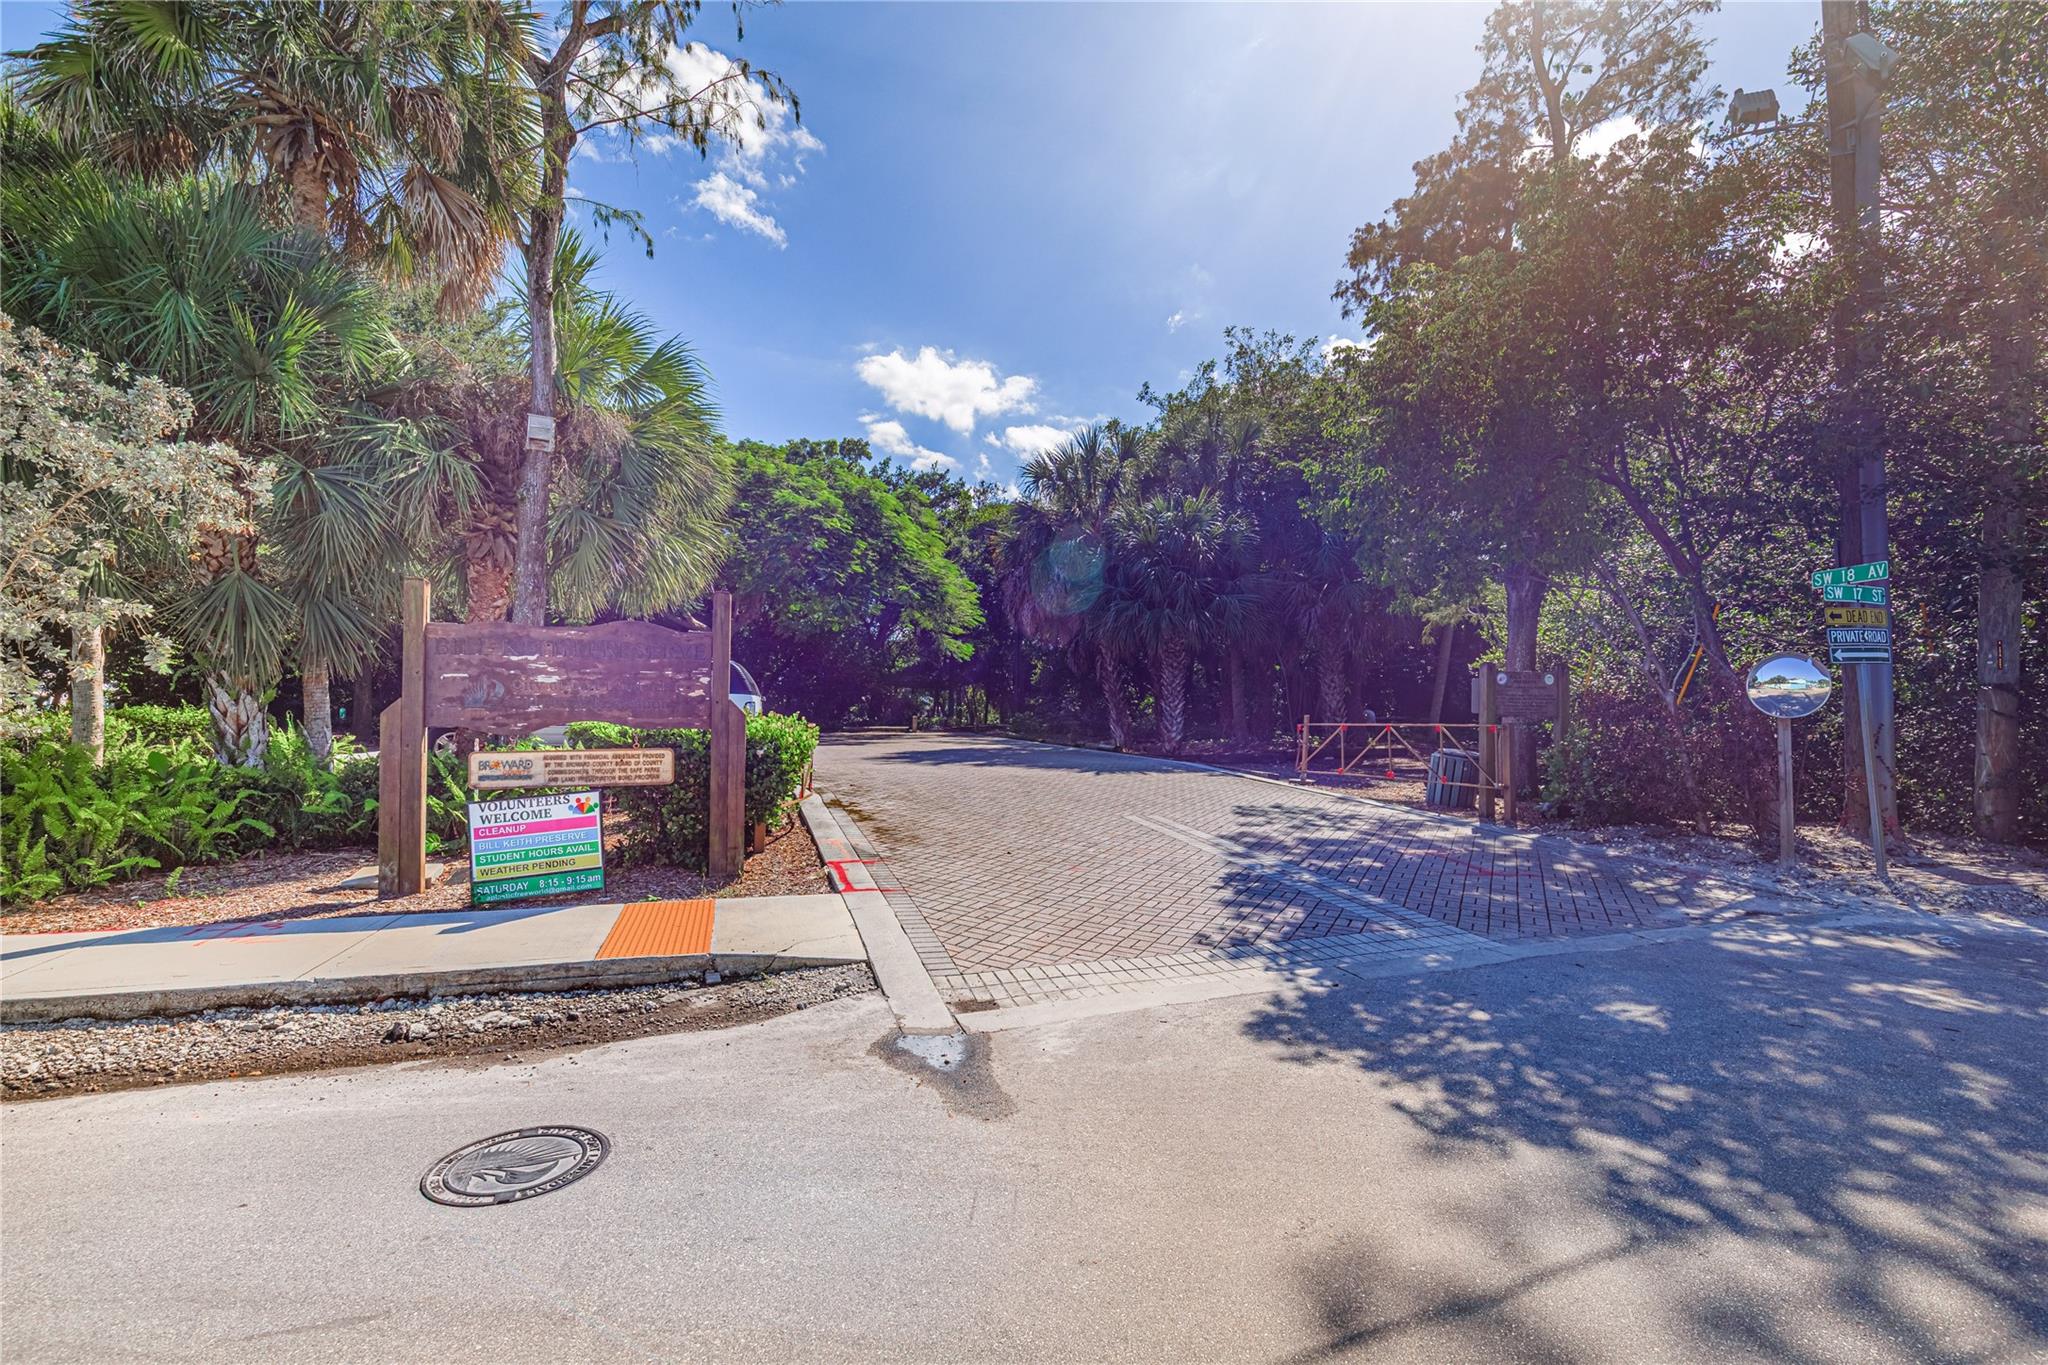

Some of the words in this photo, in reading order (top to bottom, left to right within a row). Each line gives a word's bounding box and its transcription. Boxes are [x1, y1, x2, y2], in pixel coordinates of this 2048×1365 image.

[1814, 572, 1832, 586] SW
[1841, 568, 1855, 582] 18
[1867, 563, 1885, 578] AV
[1827, 586, 1843, 599] SW
[1853, 588, 1863, 600] 17
[1872, 589, 1883, 602] ST
[1846, 610, 1868, 623] DEAD
[1870, 611, 1884, 624] END
[1830, 630, 1864, 643] PRIVATE
[1868, 631, 1887, 643] ROAD
[478, 795, 570, 813] VOLUNTEERS
[479, 808, 552, 825] WELCOME
[478, 824, 526, 836] CLEANUP
[479, 840, 501, 850] BILL
[503, 837, 532, 848] KEITH
[535, 831, 586, 845] PRESERVE
[479, 851, 526, 864] STUDENT
[528, 847, 564, 858] HOURS
[566, 844, 596, 854] AVAIL.
[480, 863, 529, 877] WEATHER
[532, 858, 576, 870] PENDING
[477, 881, 528, 896] SATURDAY
[539, 878, 559, 888] 8:15
[566, 874, 586, 885] 9:15
